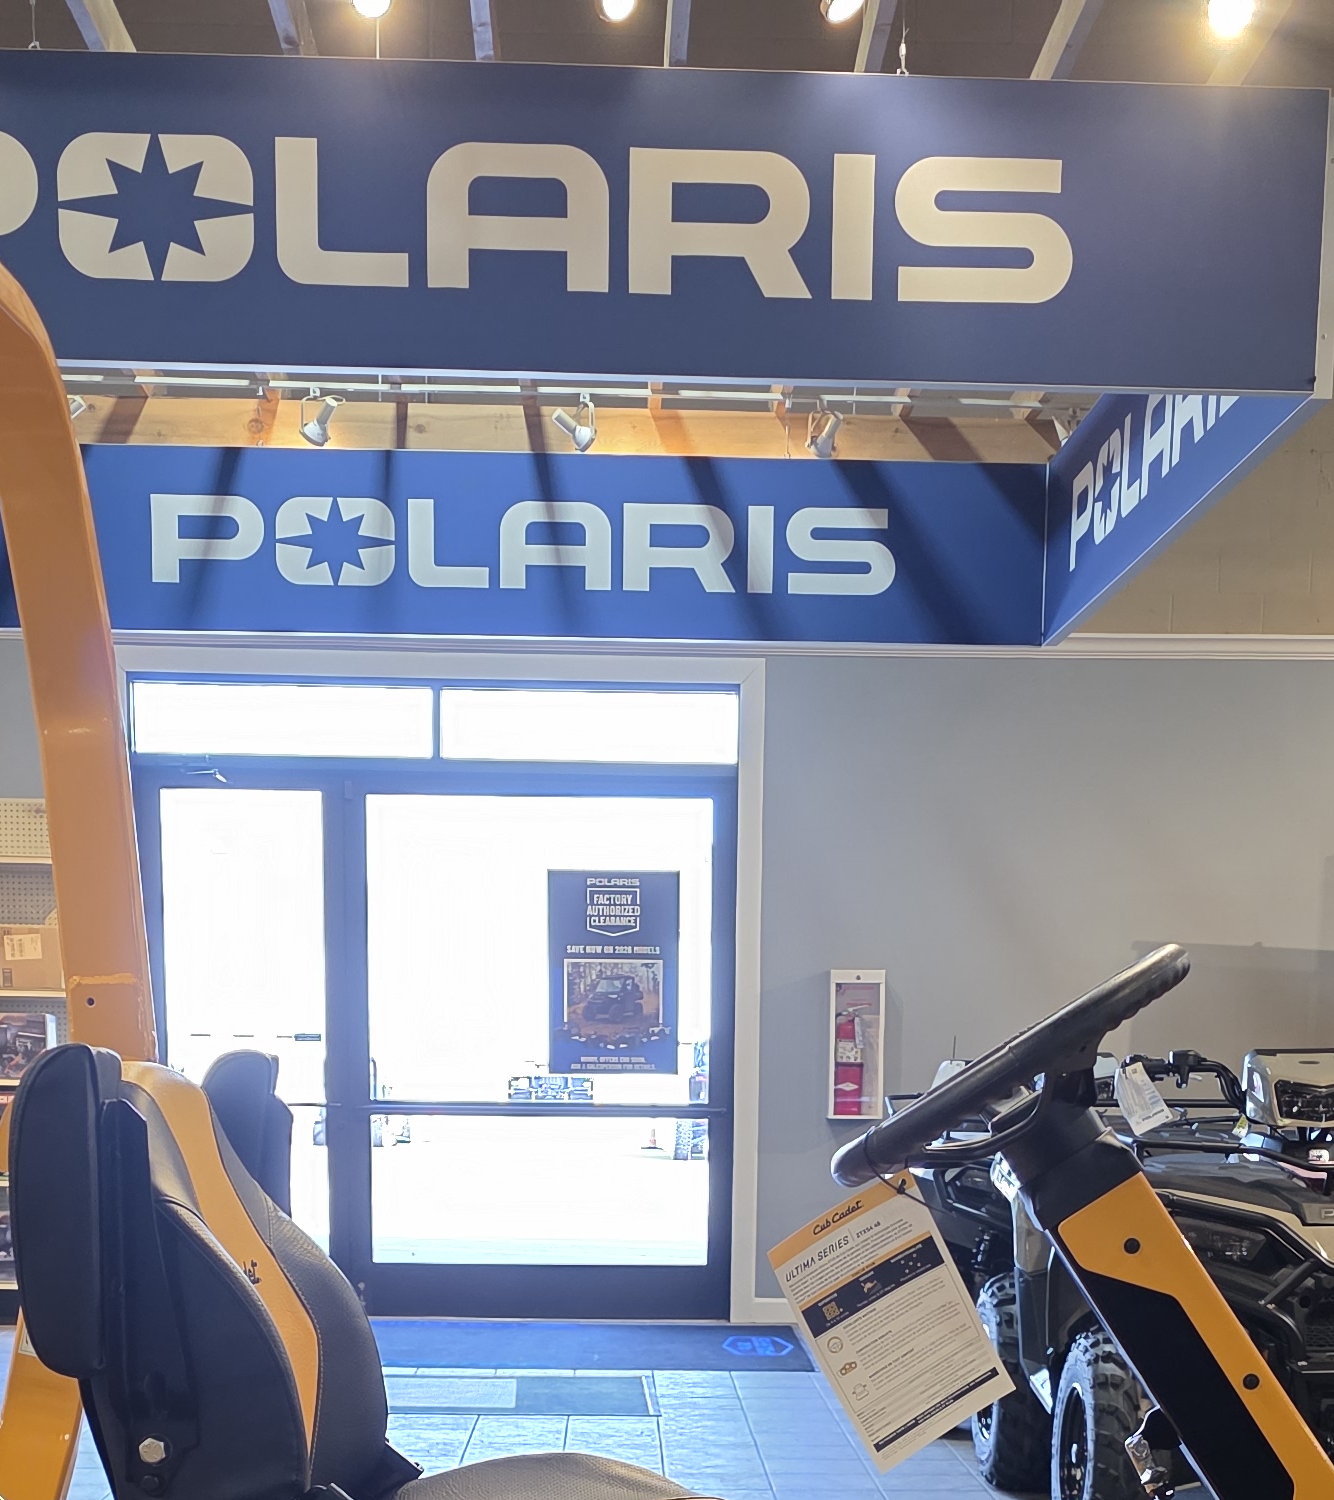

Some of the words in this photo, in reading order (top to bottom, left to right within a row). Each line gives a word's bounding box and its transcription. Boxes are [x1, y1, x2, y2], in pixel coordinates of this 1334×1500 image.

[150, 494, 896, 596] POLARIS
[587, 878, 640, 886] POLARIS
[594, 894, 633, 905] FACTORY
[587, 905, 640, 915] AUTHORIZED
[591, 916, 635, 926] CLEARANCE
[812, 1218, 831, 1236] Cub
[832, 1200, 864, 1224] Cadet
[785, 1256, 816, 1283] ULTIMA
[817, 1235, 850, 1261] SERIES
